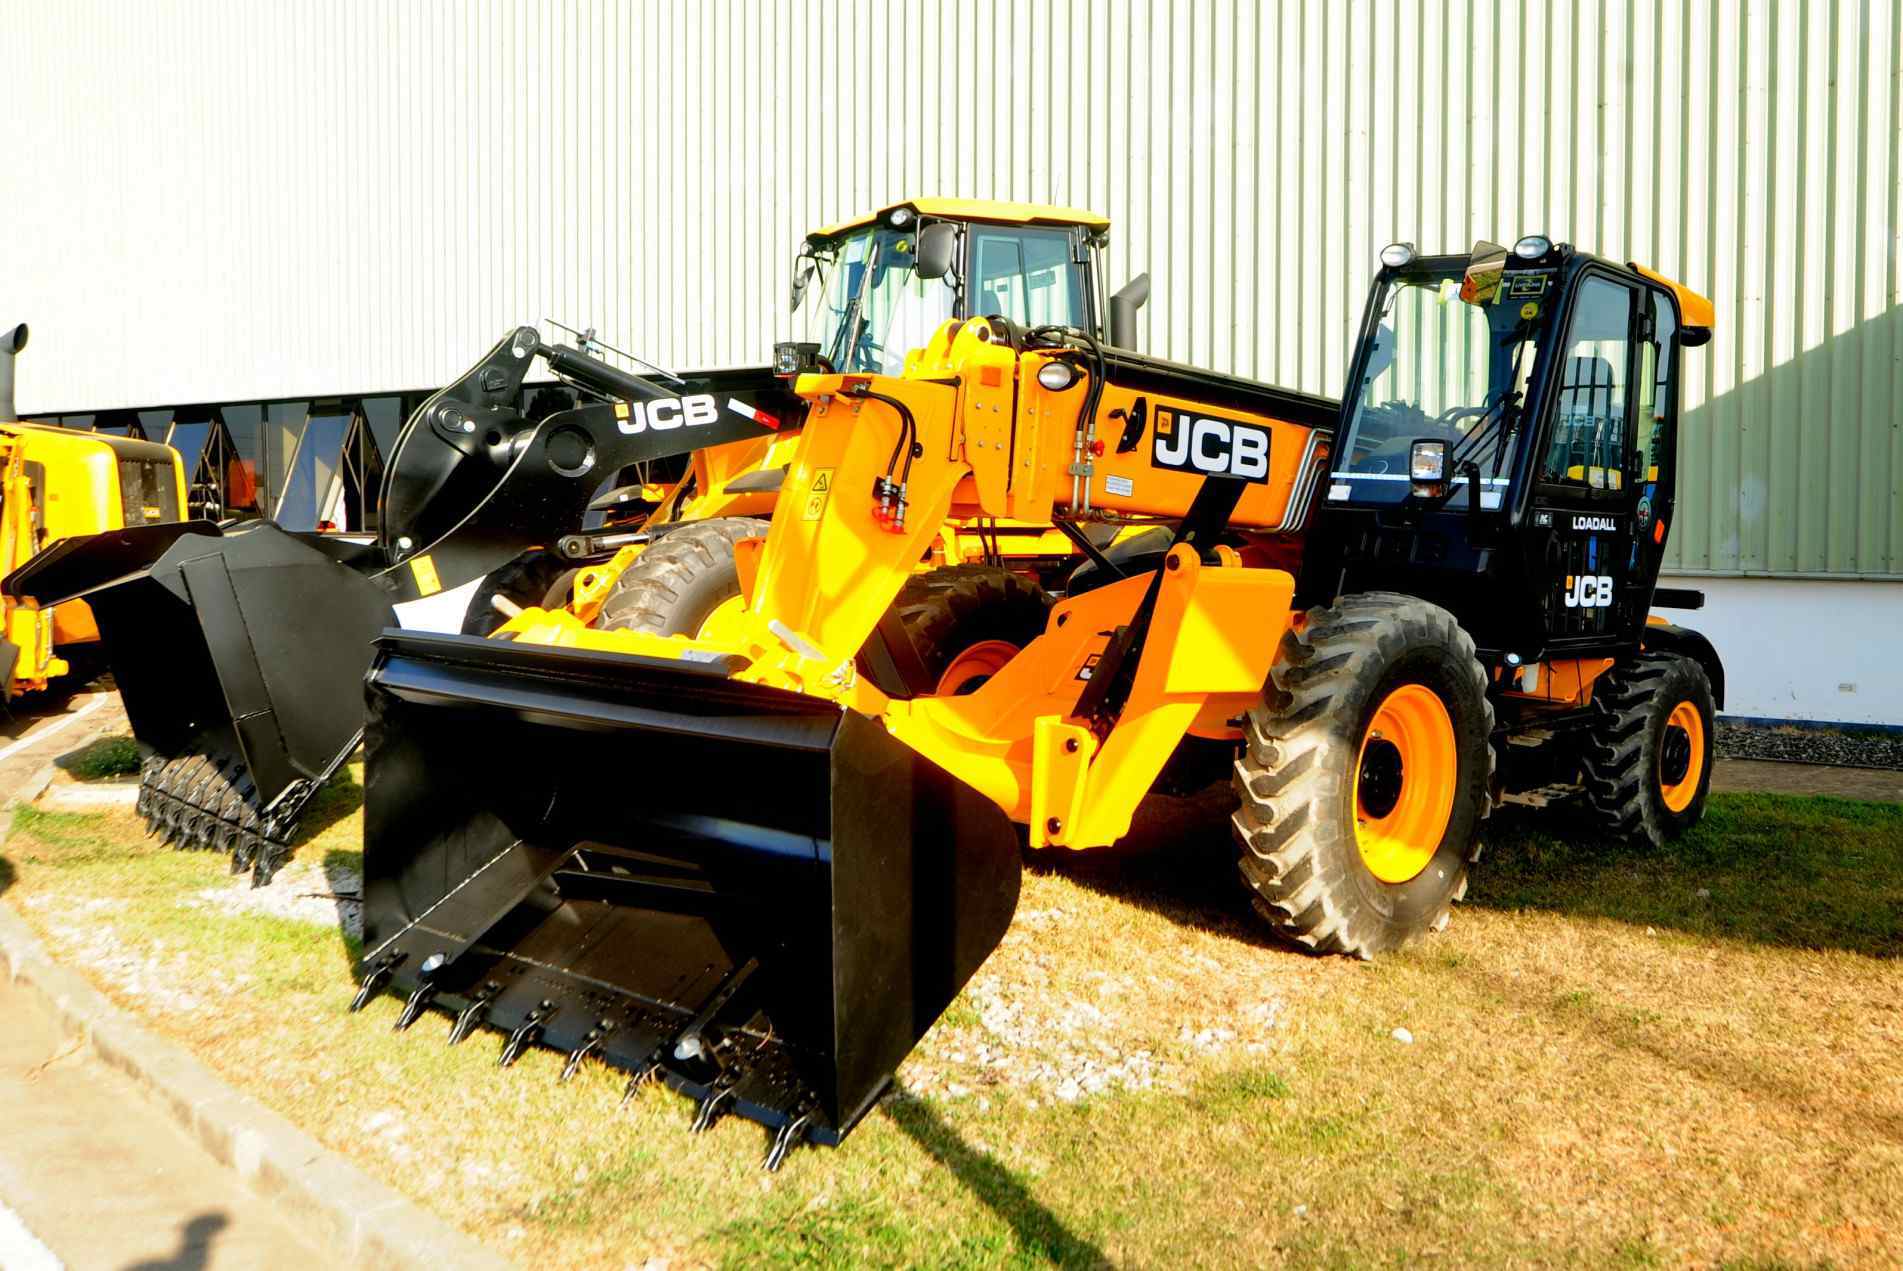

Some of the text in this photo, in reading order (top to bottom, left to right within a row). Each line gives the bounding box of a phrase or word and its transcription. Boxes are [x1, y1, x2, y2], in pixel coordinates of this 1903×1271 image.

[616, 394, 718, 434] JCB
[1155, 413, 1268, 478] JCB
[1572, 516, 1616, 531] LOADALL
[1564, 575, 1613, 607] JCB
